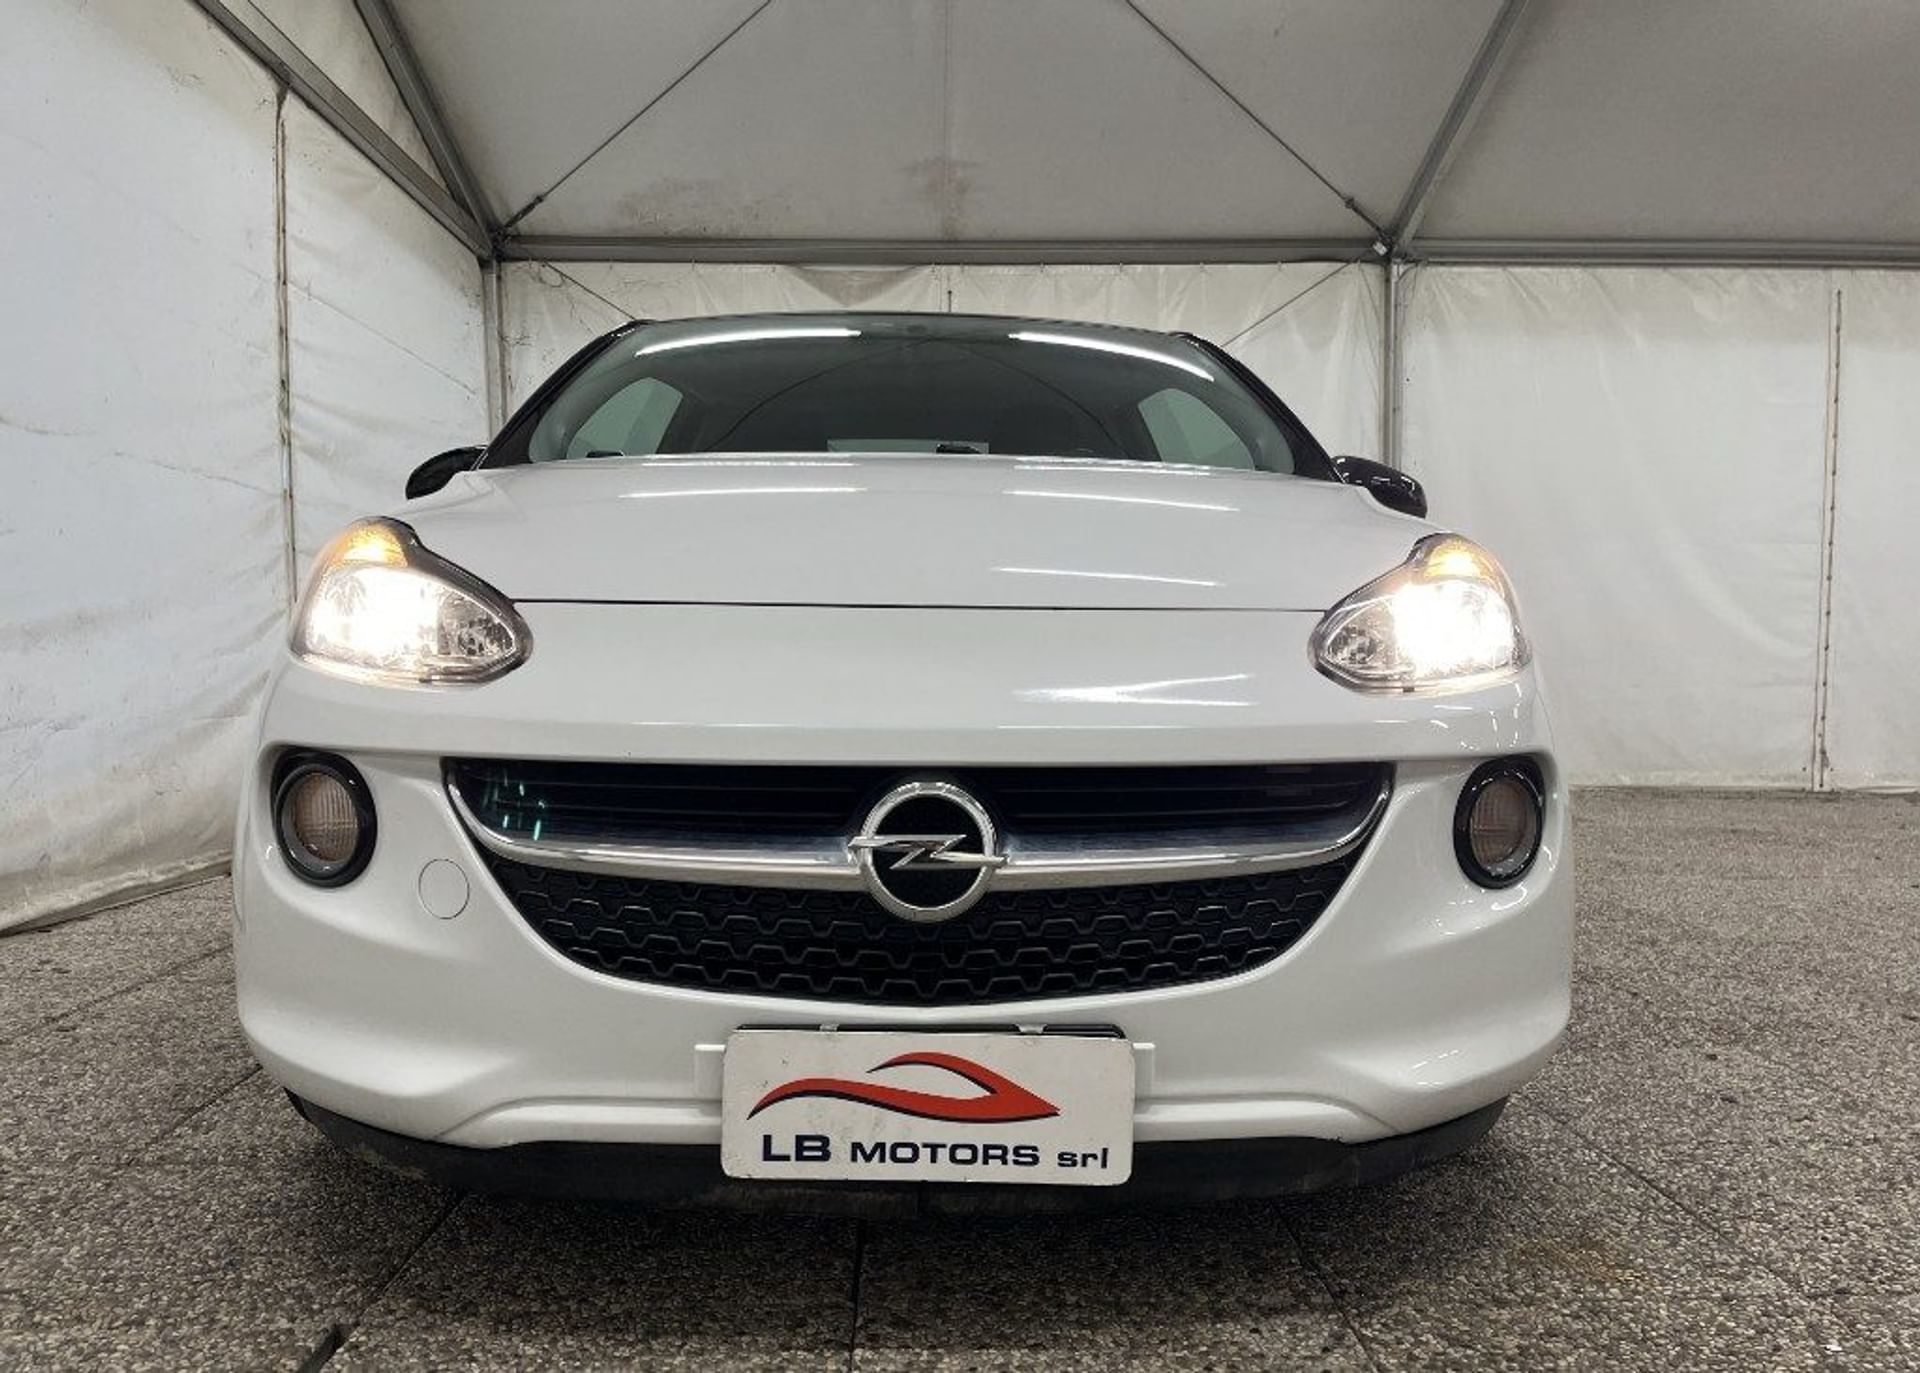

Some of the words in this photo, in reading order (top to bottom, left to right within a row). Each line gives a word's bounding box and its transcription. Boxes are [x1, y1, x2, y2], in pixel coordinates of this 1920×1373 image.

[761, 1133, 831, 1163] LB
[849, 1141, 1040, 1167] MOTORS
[1056, 1147, 1108, 1169] srl
